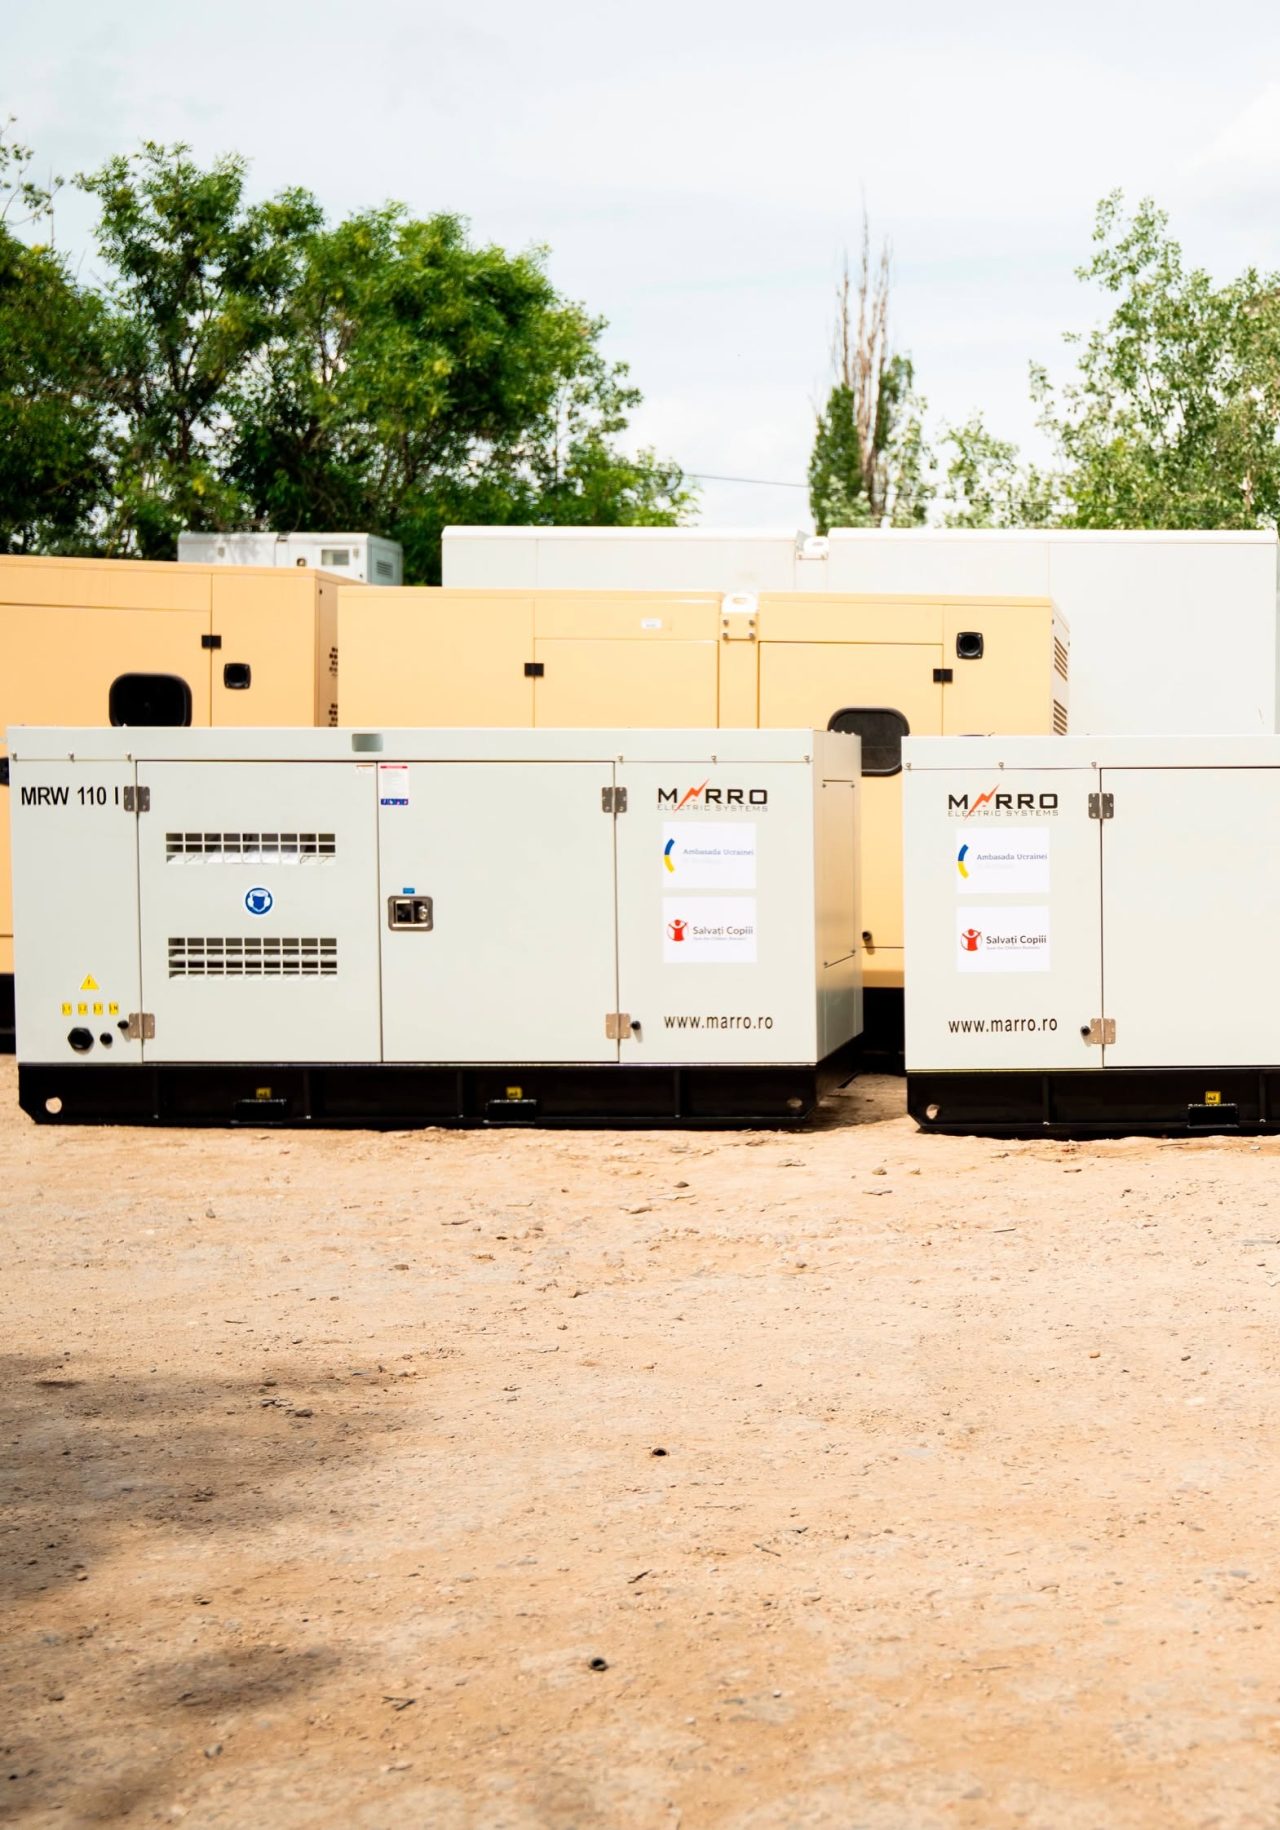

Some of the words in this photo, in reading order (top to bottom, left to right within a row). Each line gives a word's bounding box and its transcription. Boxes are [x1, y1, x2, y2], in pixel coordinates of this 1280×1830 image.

[21, 786, 69, 806] MRW
[77, 786, 107, 806] 110
[114, 786, 119, 806] I
[715, 805, 769, 813] SYSTEMS
[1006, 809, 1060, 817] SYSTEMS
[976, 852, 1015, 861] Ambasada
[1019, 934, 1048, 946] Copiii
[663, 1015, 774, 1030] www.marro.ro
[948, 1017, 1059, 1034] www.marro.ro
